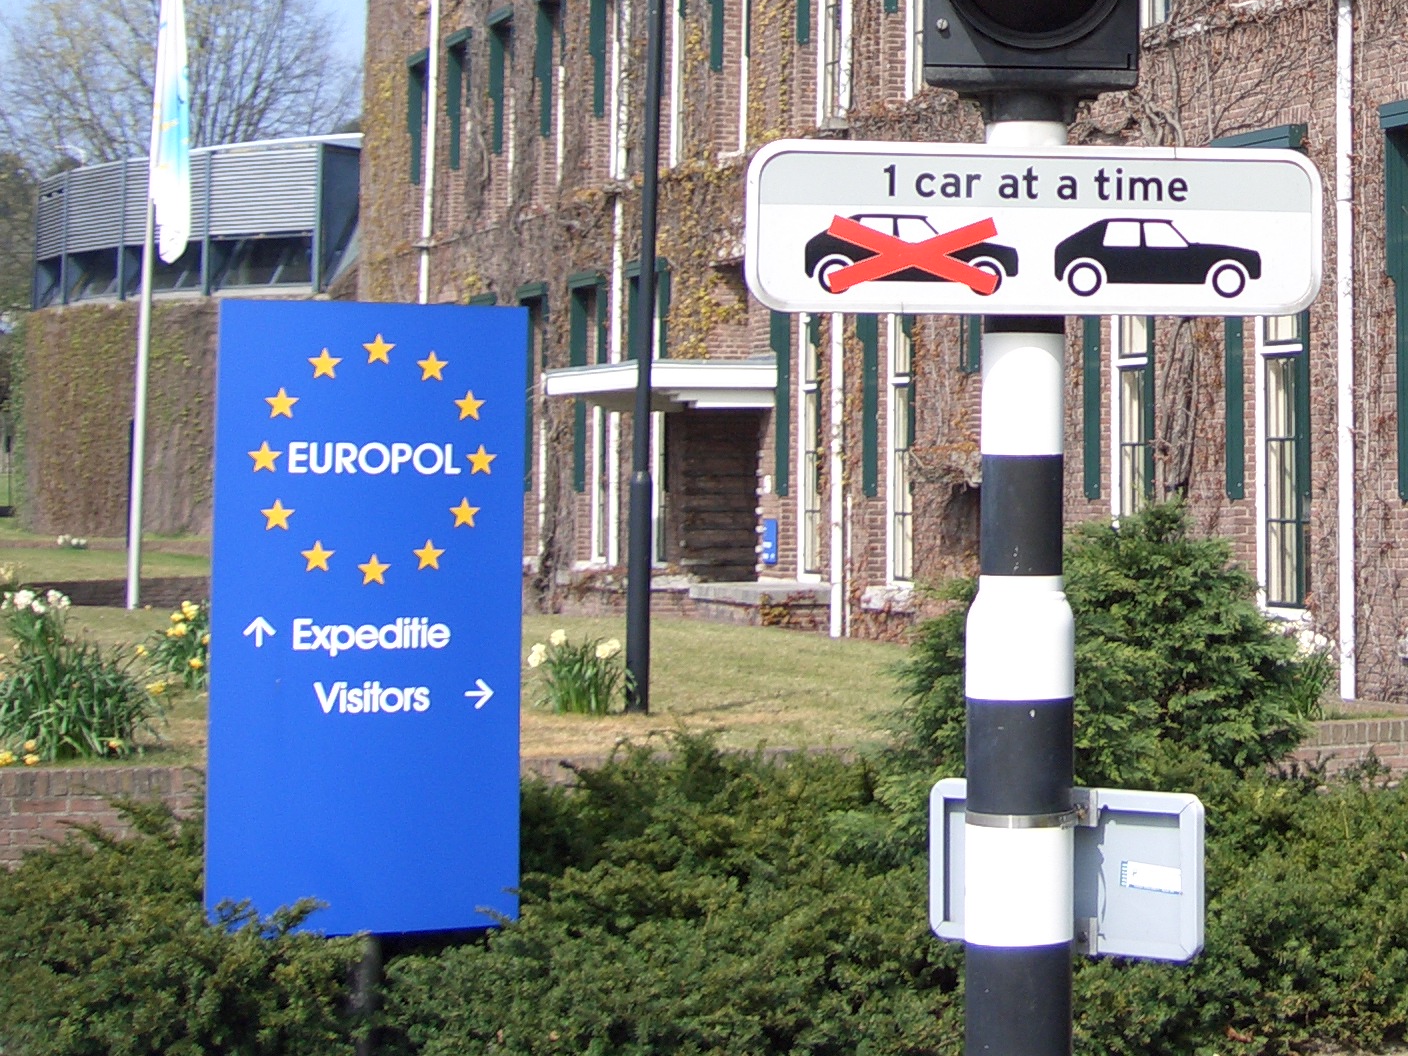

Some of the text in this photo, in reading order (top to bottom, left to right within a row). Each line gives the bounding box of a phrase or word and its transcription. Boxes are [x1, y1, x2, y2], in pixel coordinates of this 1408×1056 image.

[884, 165, 1187, 201] 1 car at a time
[288, 442, 460, 474] EUROPOL
[293, 617, 450, 657] Expeditie
[314, 681, 429, 713] Visitors
